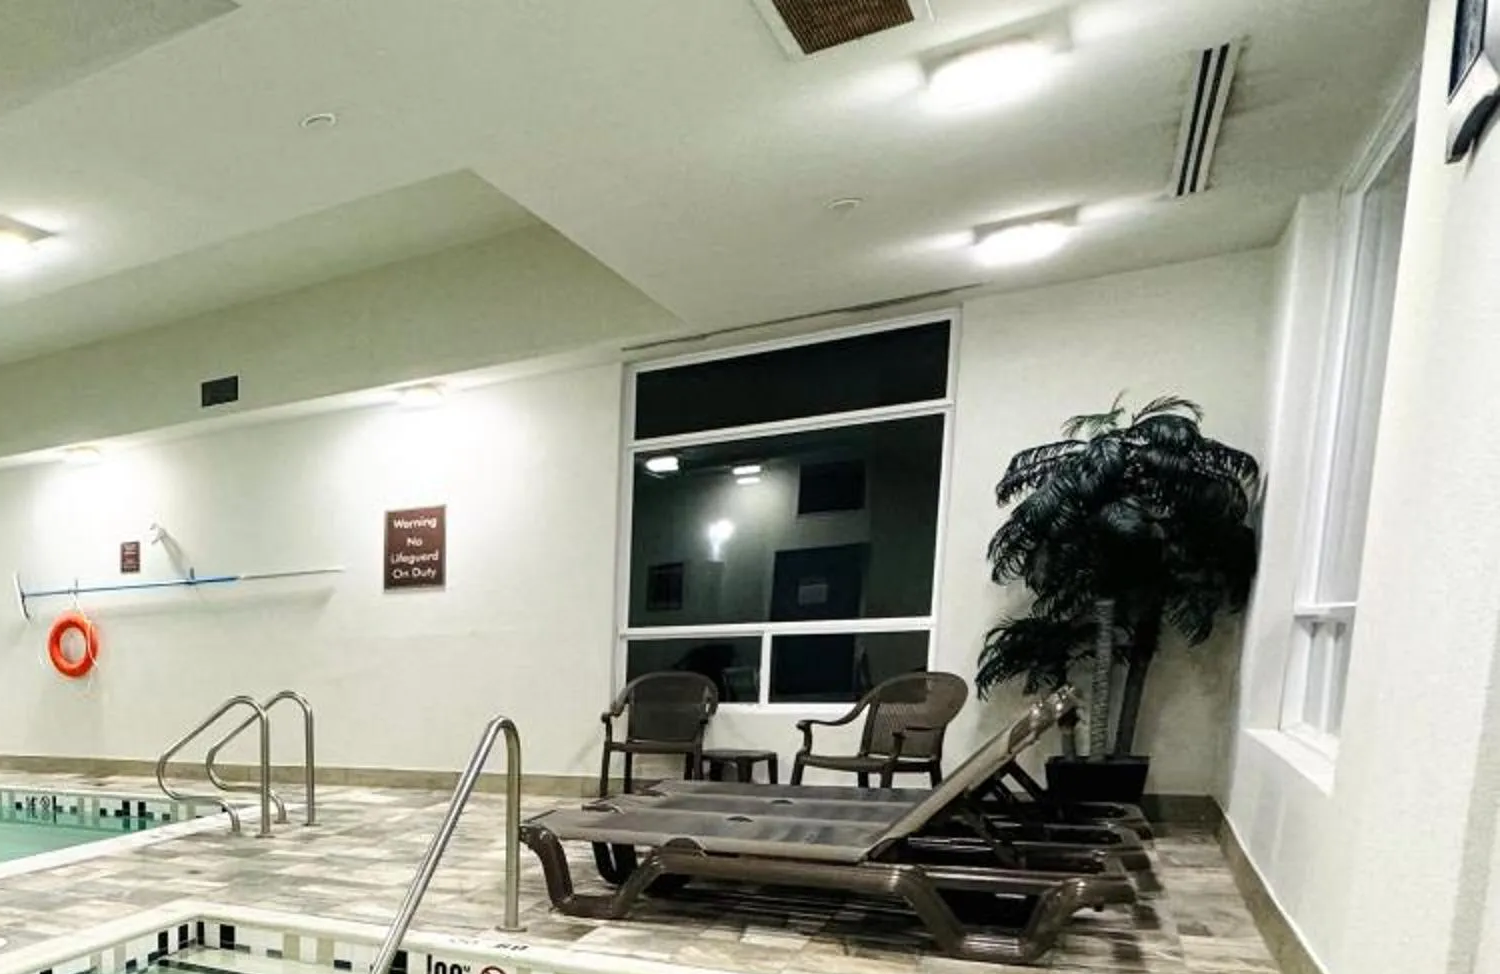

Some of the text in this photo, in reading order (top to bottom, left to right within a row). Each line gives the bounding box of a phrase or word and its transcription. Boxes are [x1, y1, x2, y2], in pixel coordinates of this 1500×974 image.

[393, 516, 438, 529] Warning
[406, 537, 423, 547] No
[391, 549, 440, 565] Lifeguard
[411, 567, 437, 579] Duty
